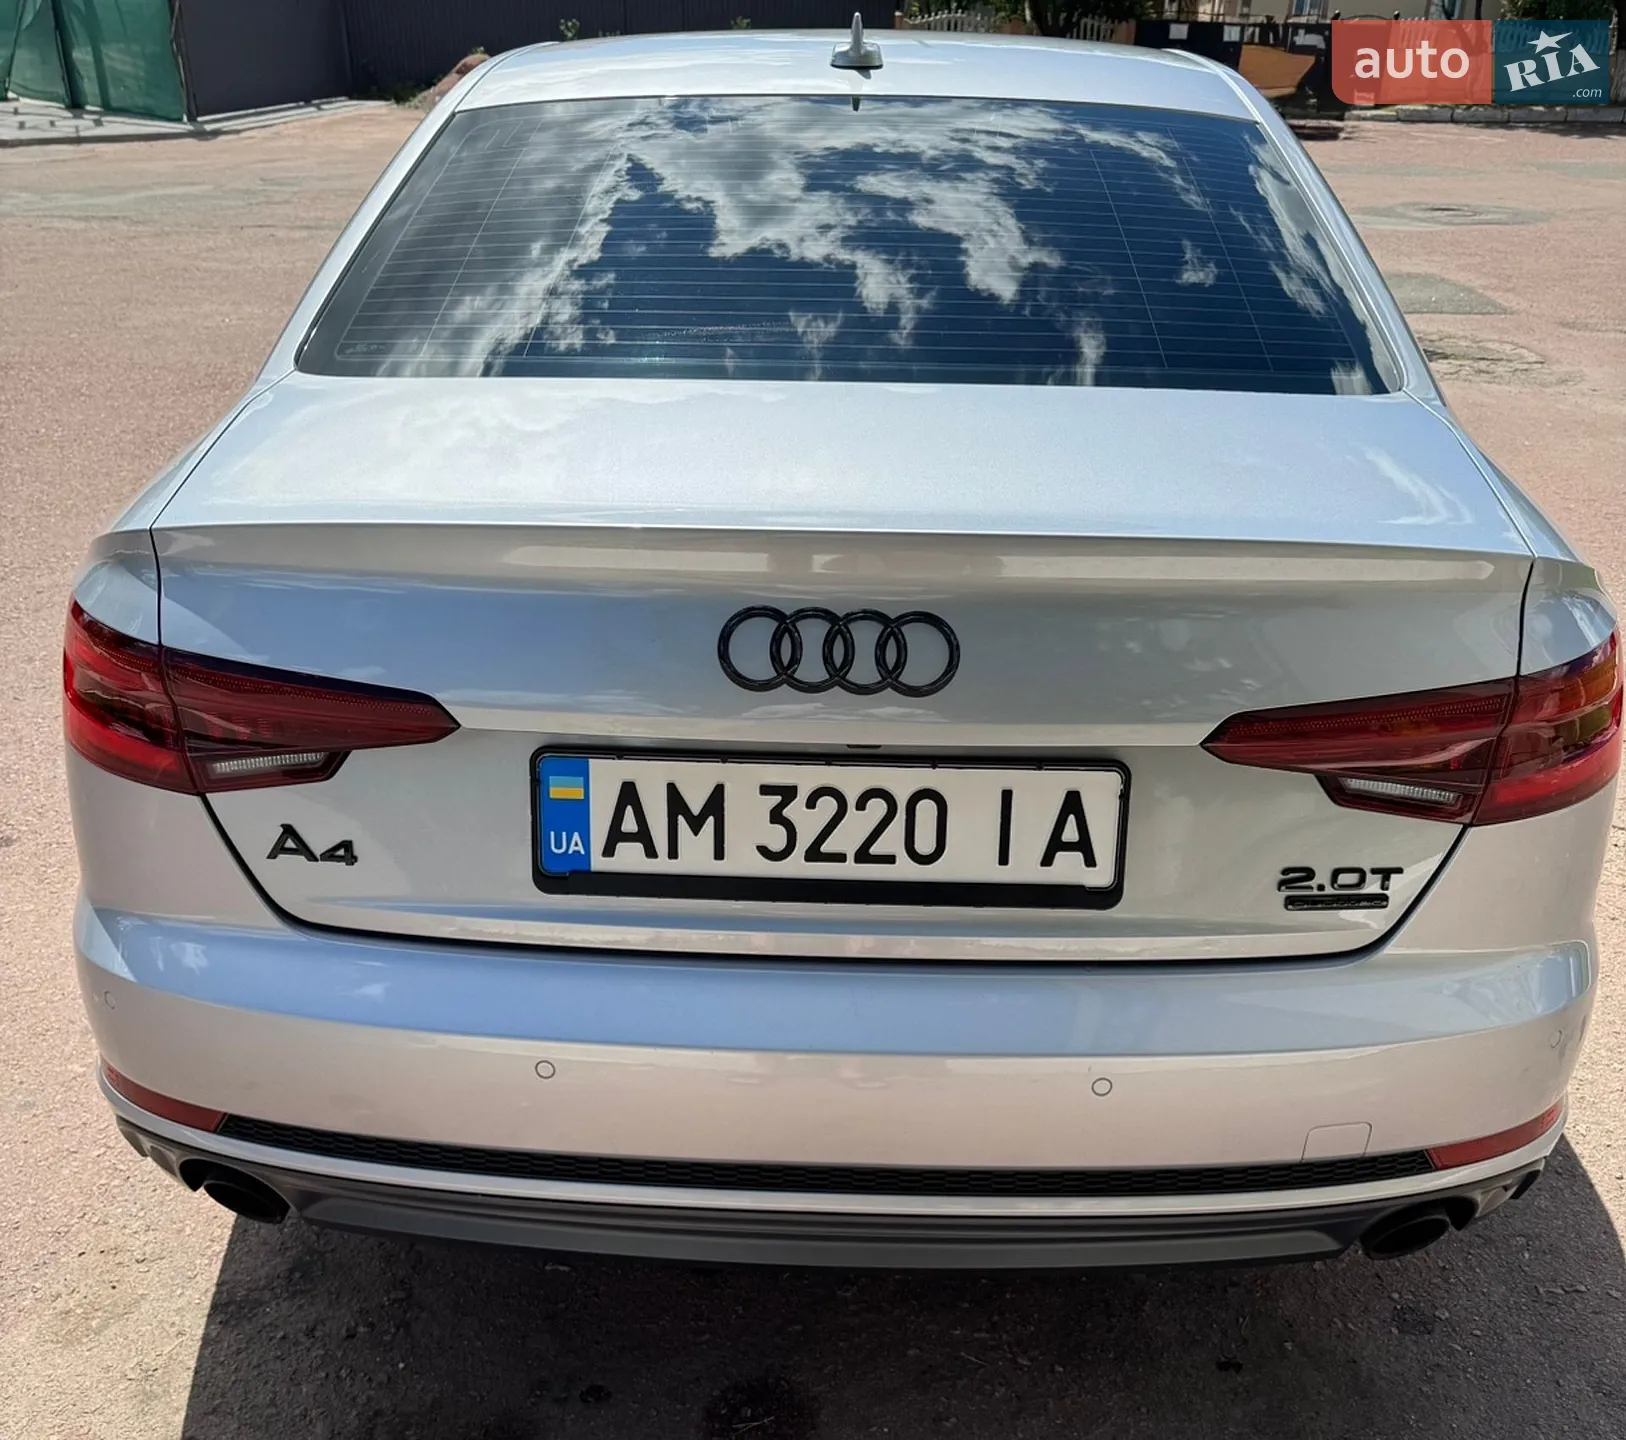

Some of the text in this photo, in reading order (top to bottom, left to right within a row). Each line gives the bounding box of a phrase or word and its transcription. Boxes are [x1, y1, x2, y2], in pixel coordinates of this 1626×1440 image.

[601, 781, 725, 861] AM
[756, 784, 948, 866] 3220
[266, 823, 358, 866] A4
[550, 831, 585, 854] UA
[1277, 866, 1404, 892] 2.0T
